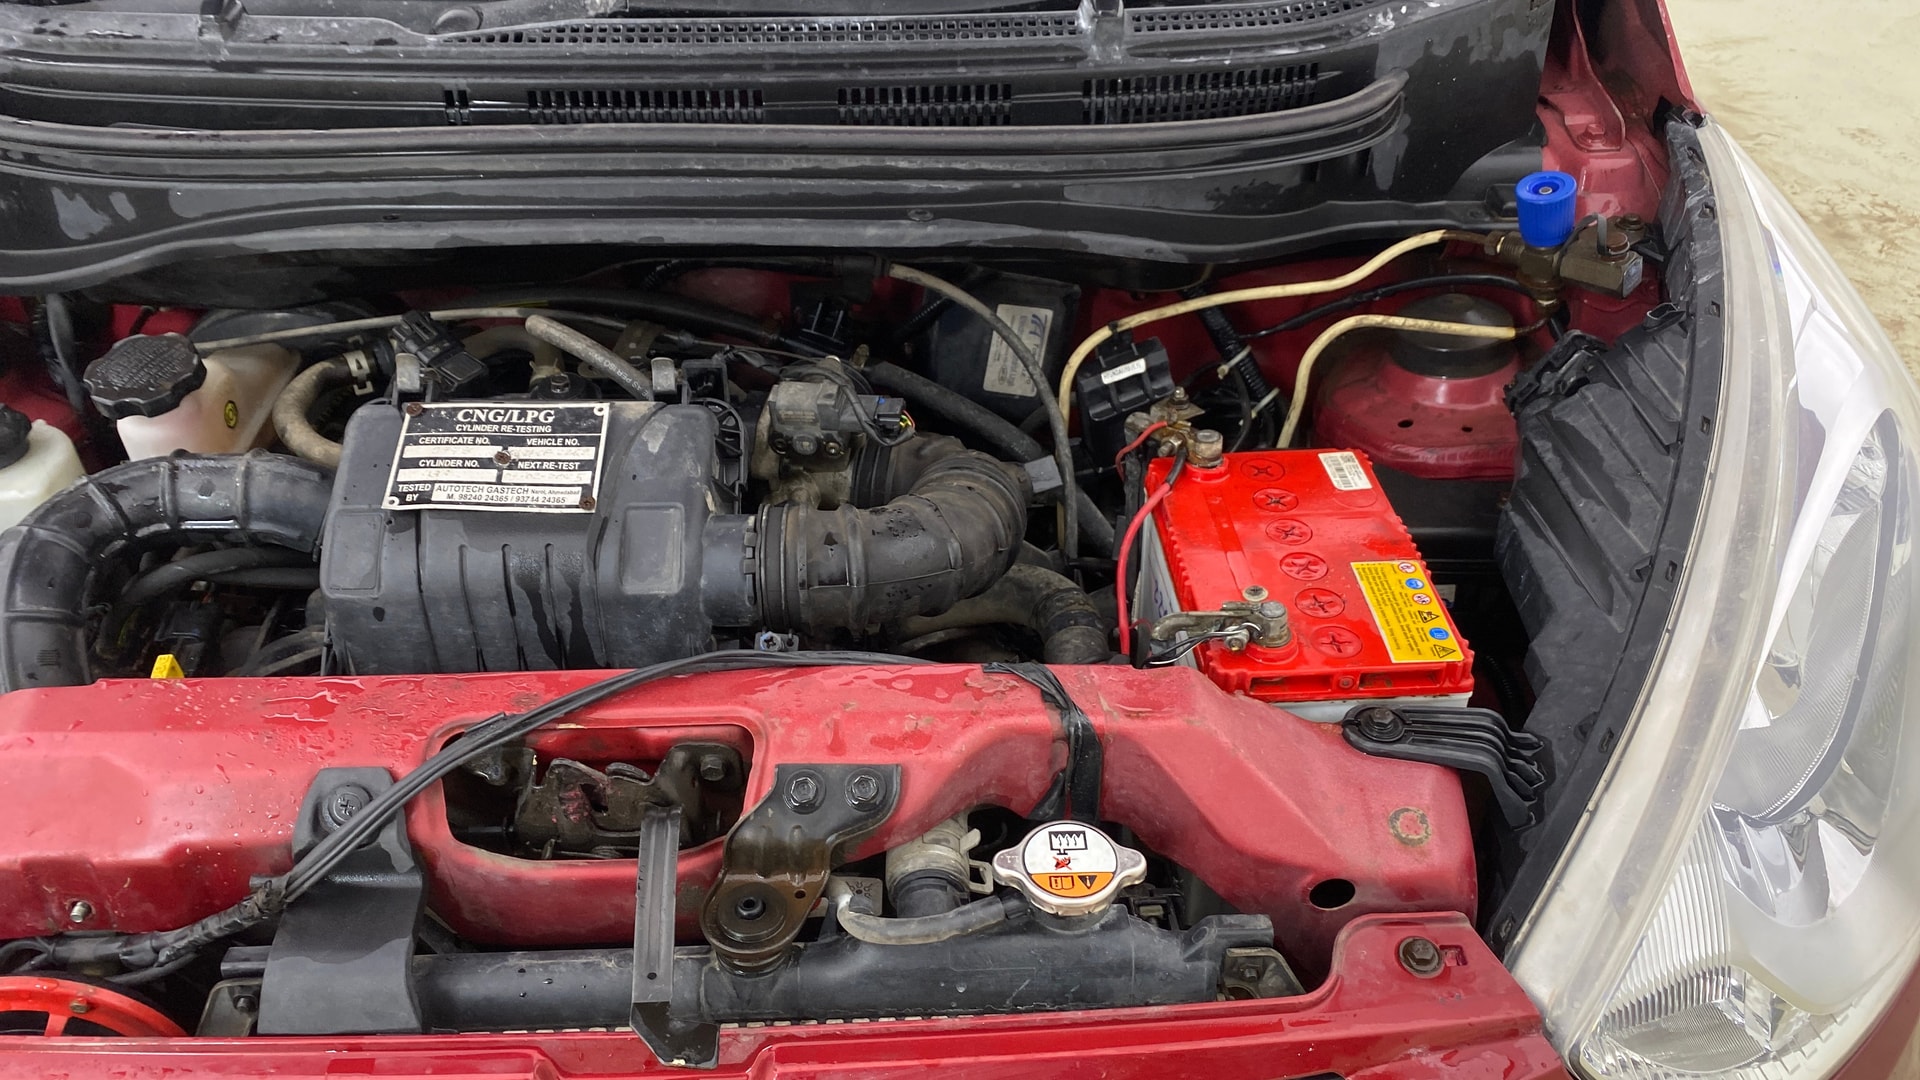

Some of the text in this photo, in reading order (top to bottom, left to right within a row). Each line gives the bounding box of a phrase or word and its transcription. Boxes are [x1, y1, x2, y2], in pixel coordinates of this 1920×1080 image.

[603, 360, 617, 371] ISO
[616, 370, 632, 383] PER
[456, 408, 555, 424] CNG/LPG
[455, 423, 552, 433] CYLINDER RE-TESTING
[418, 436, 491, 445] CERTIFICATE NO.
[526, 438, 580, 446] VEHICLE NO.
[418, 459, 480, 468] CYLINDER NO.
[517, 461, 580, 470] NEXT RE-TEST
[398, 484, 431, 492] TESTED
[435, 485, 485, 493] AUTOTECH
[486, 486, 529, 495] GASTECH
[405, 493, 419, 502] BY
[446, 493, 456, 501] M.
[458, 493, 482, 501] 98240
[484, 494, 509, 502] 24365
[541, 496, 566, 504] 24365
